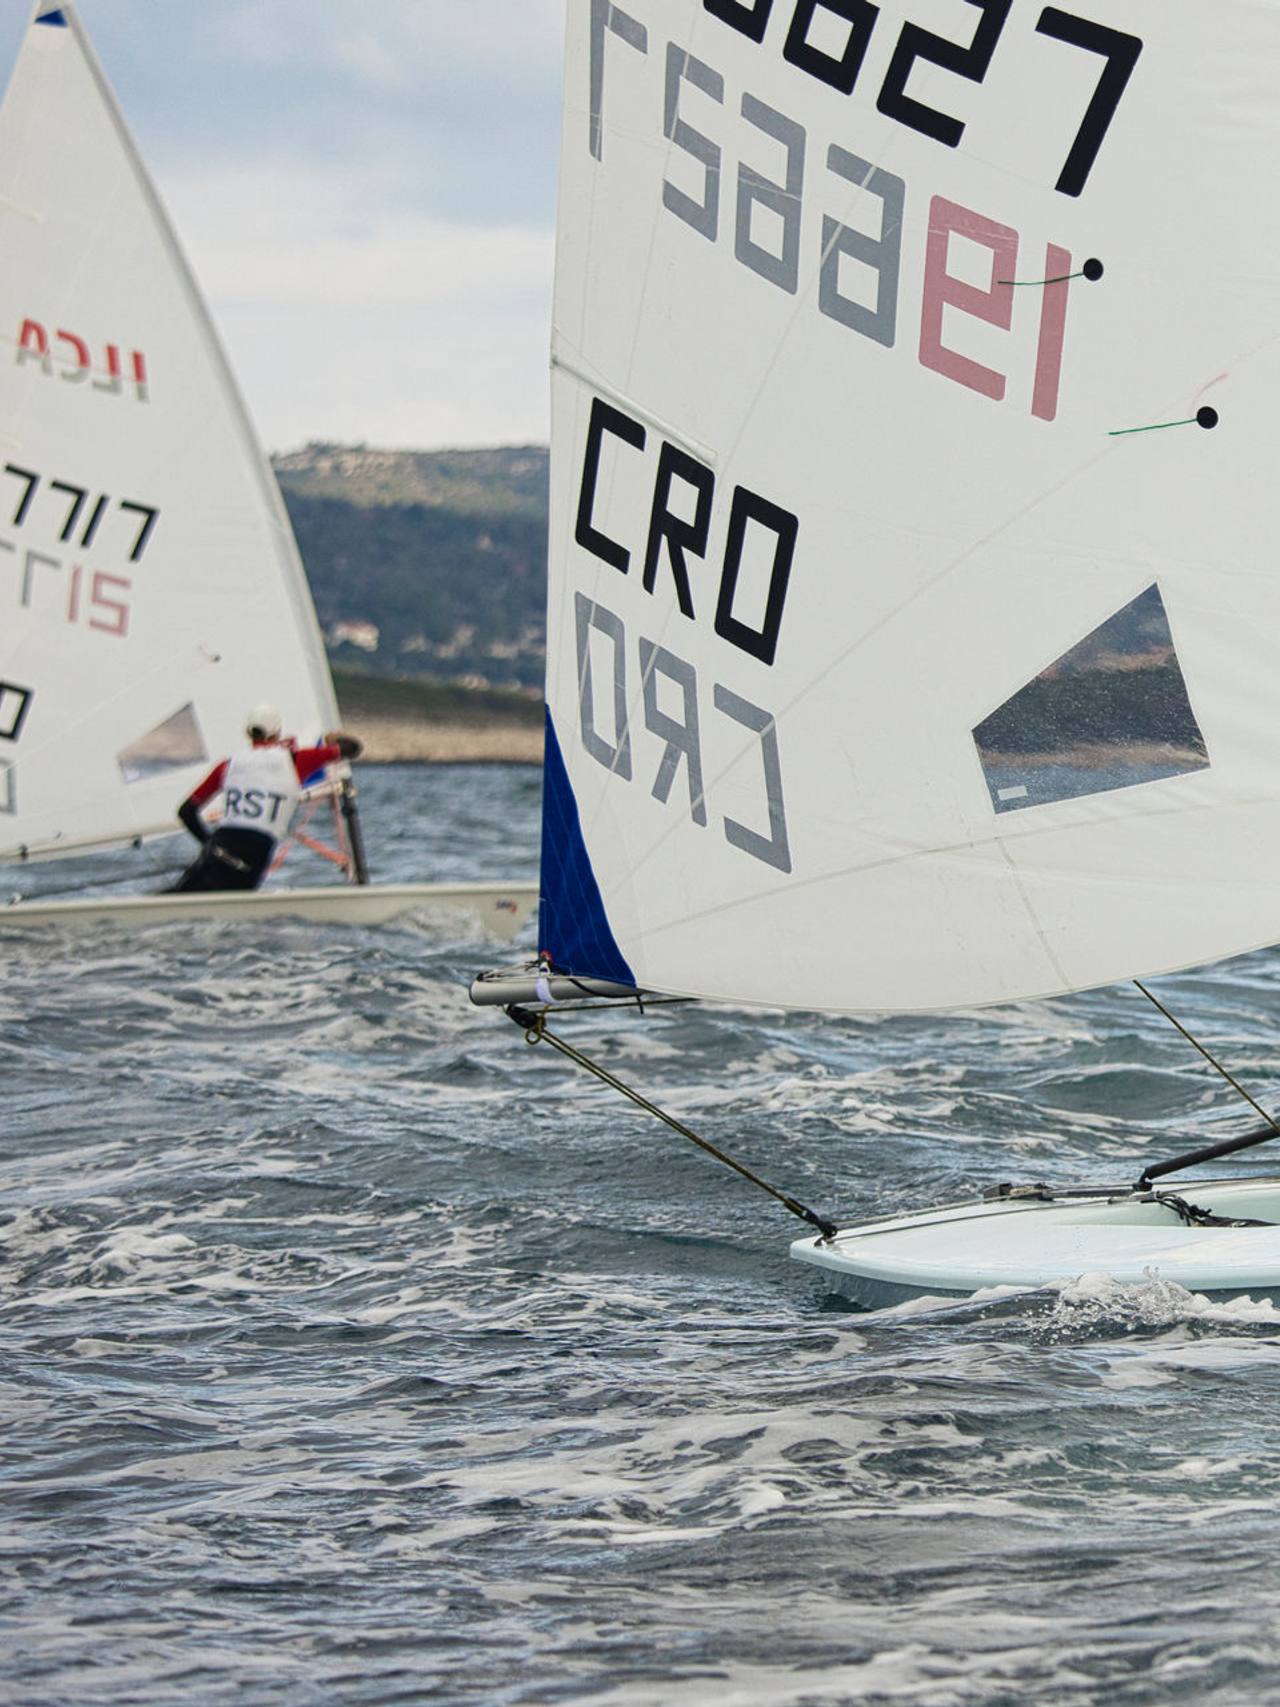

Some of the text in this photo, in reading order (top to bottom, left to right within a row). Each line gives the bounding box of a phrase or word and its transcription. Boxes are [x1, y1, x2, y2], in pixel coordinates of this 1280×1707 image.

[702, 0, 1143, 198] 627
[575, 397, 799, 666] CRO
[224, 786, 288, 822] RST
